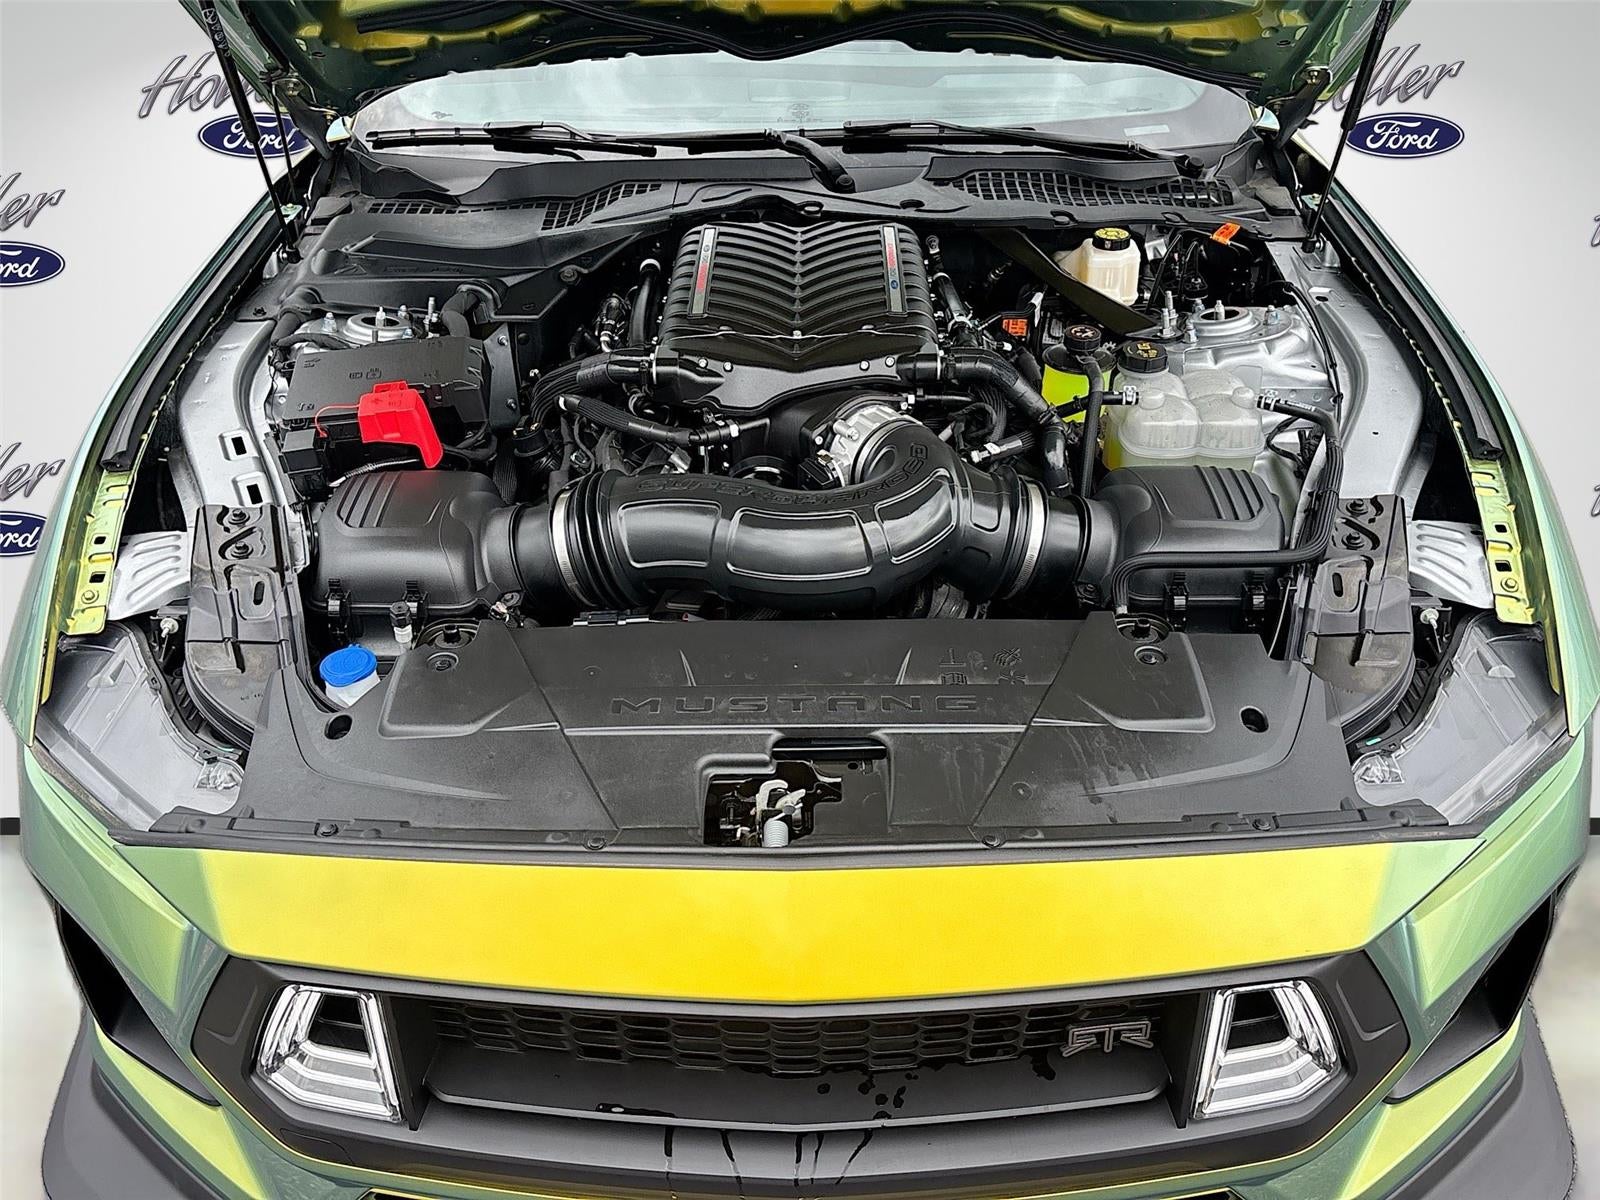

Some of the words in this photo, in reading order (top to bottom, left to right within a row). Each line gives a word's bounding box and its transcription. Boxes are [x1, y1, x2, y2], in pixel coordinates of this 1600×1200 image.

[223, 119, 299, 150] Frd
[1366, 119, 1440, 150] Ford
[610, 694, 978, 714] MUSTANG
